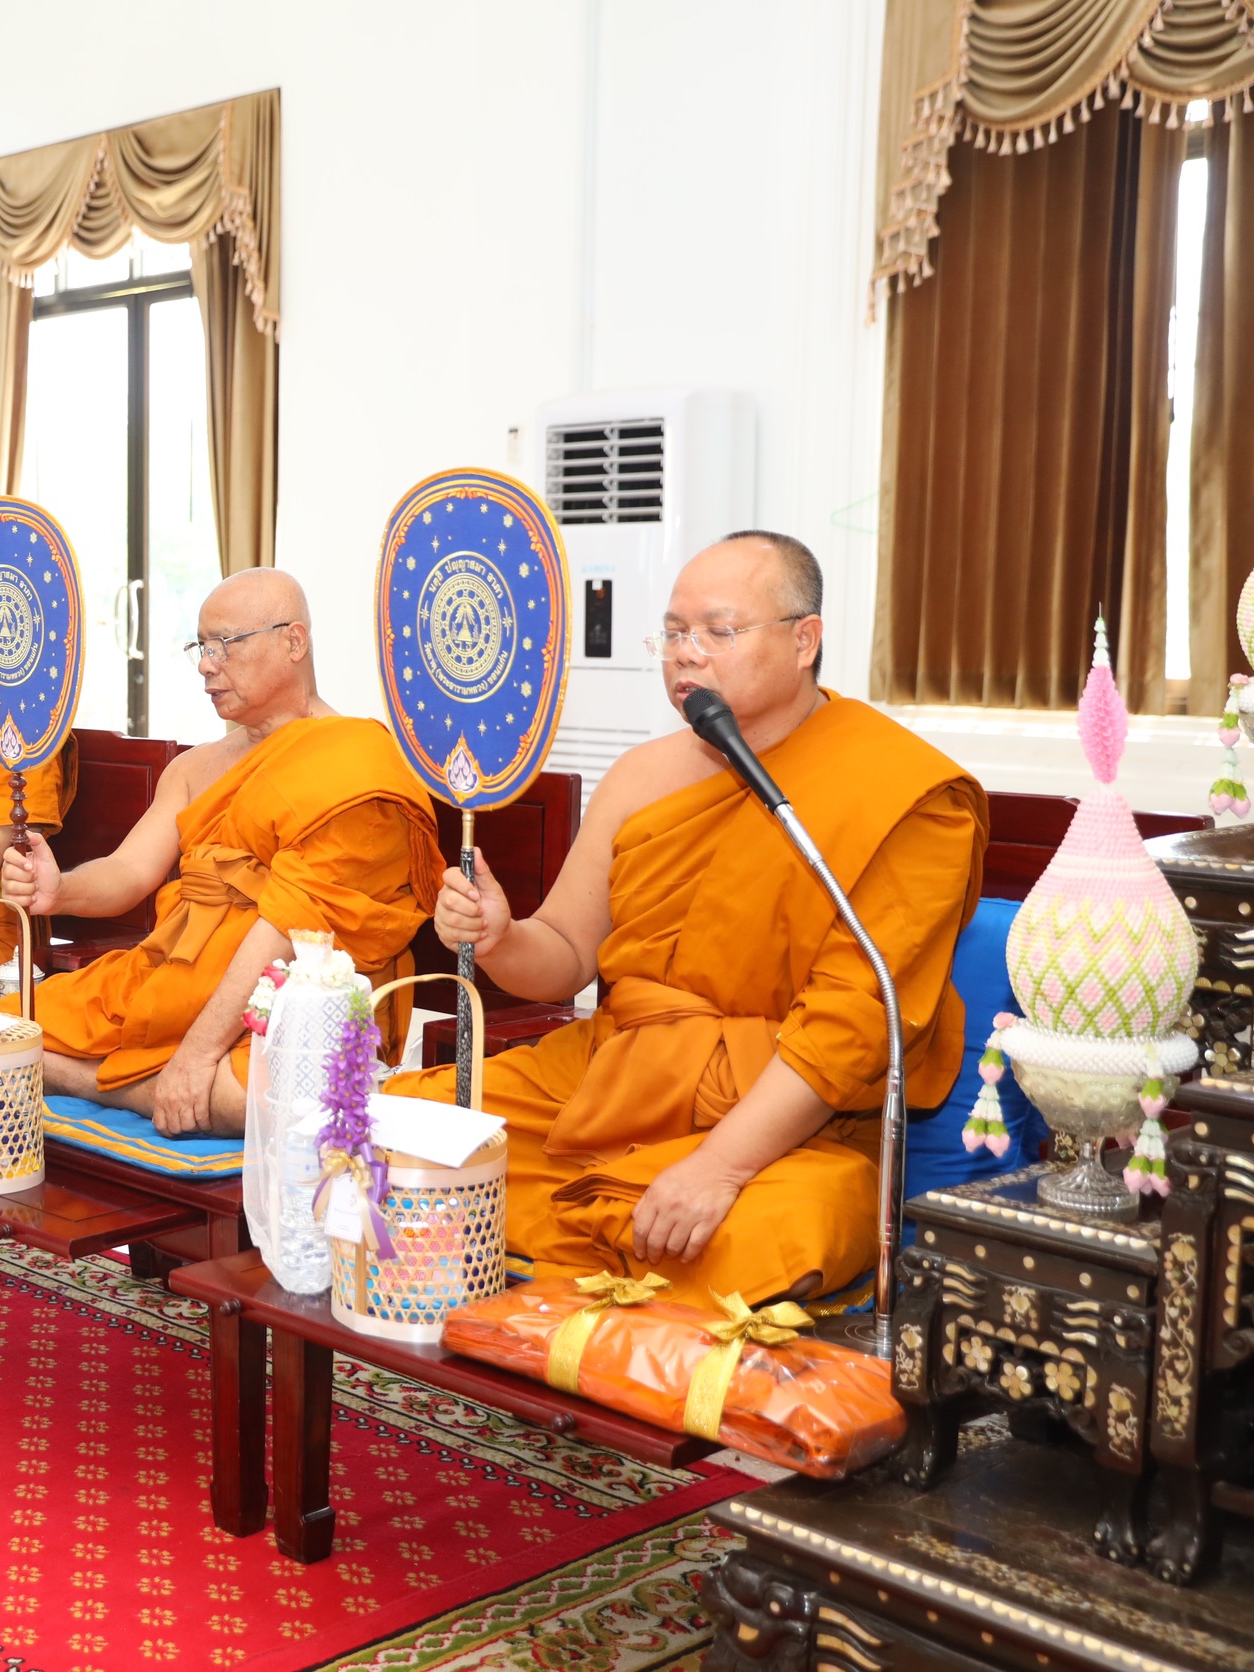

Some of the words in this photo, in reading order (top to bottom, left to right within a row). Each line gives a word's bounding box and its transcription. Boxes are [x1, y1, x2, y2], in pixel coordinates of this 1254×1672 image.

[487, 573, 503, 598] อาภา
[424, 642, 437, 673] วัดธาตุ
[488, 651, 507, 684] ขอนแก่น
